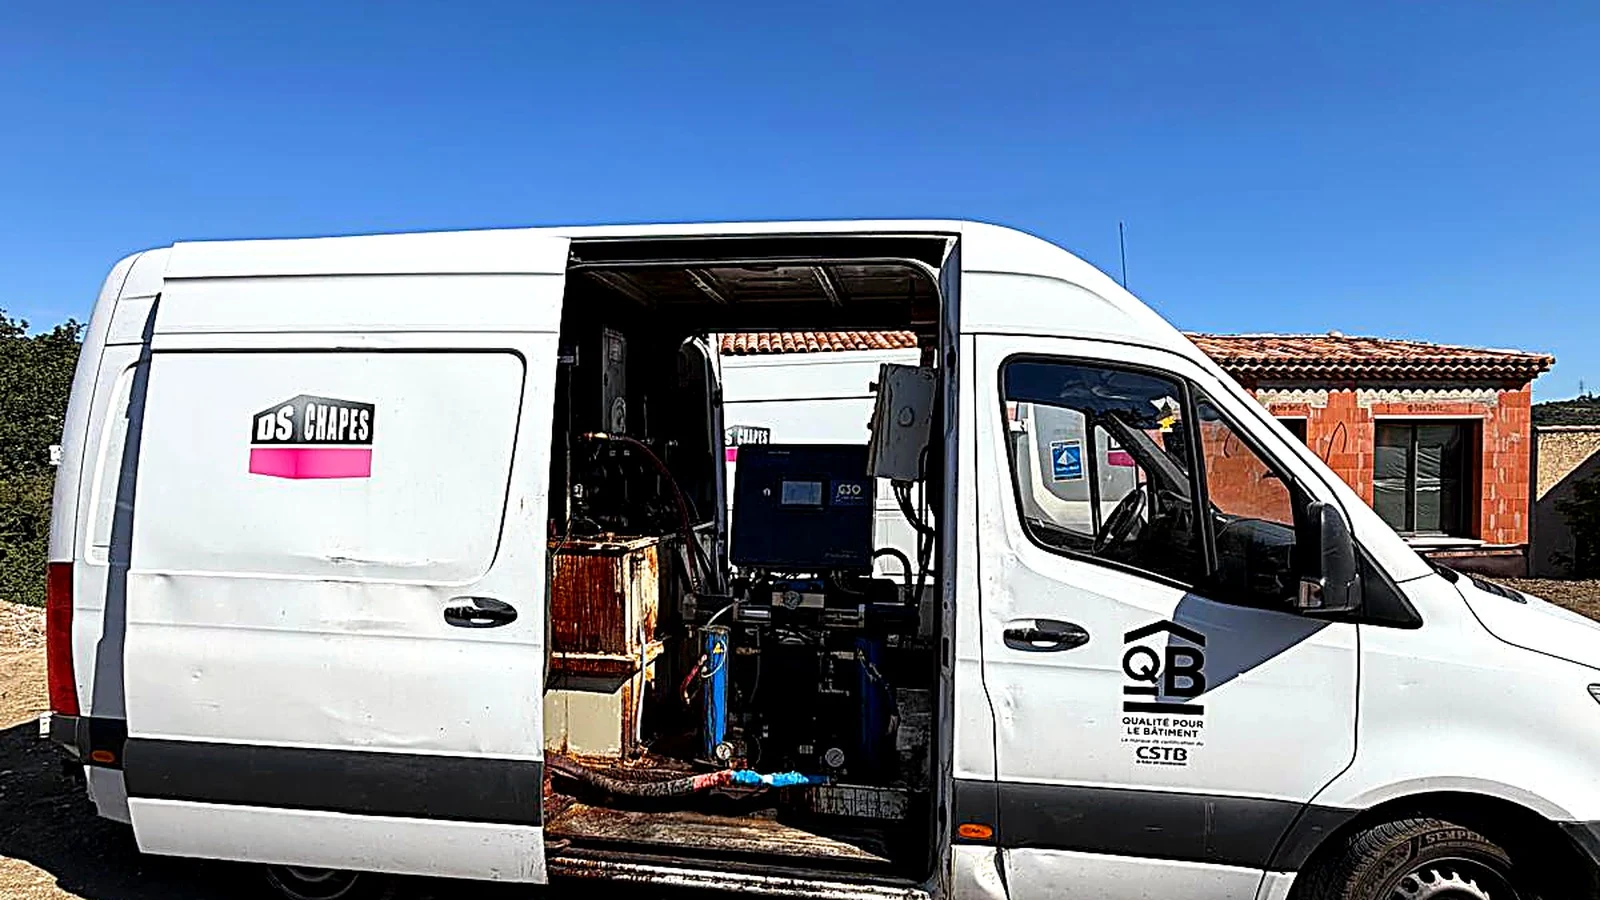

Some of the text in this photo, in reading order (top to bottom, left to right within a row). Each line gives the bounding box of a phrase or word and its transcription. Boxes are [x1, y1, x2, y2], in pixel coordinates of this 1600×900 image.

[256, 402, 370, 441] DS CHAPES
[1122, 645, 1207, 698] QB
[1122, 717, 1204, 729] QUALITÉ POUR
[1127, 726, 1199, 738] LE BÂTIMENT
[1136, 746, 1187, 761] CSTB
